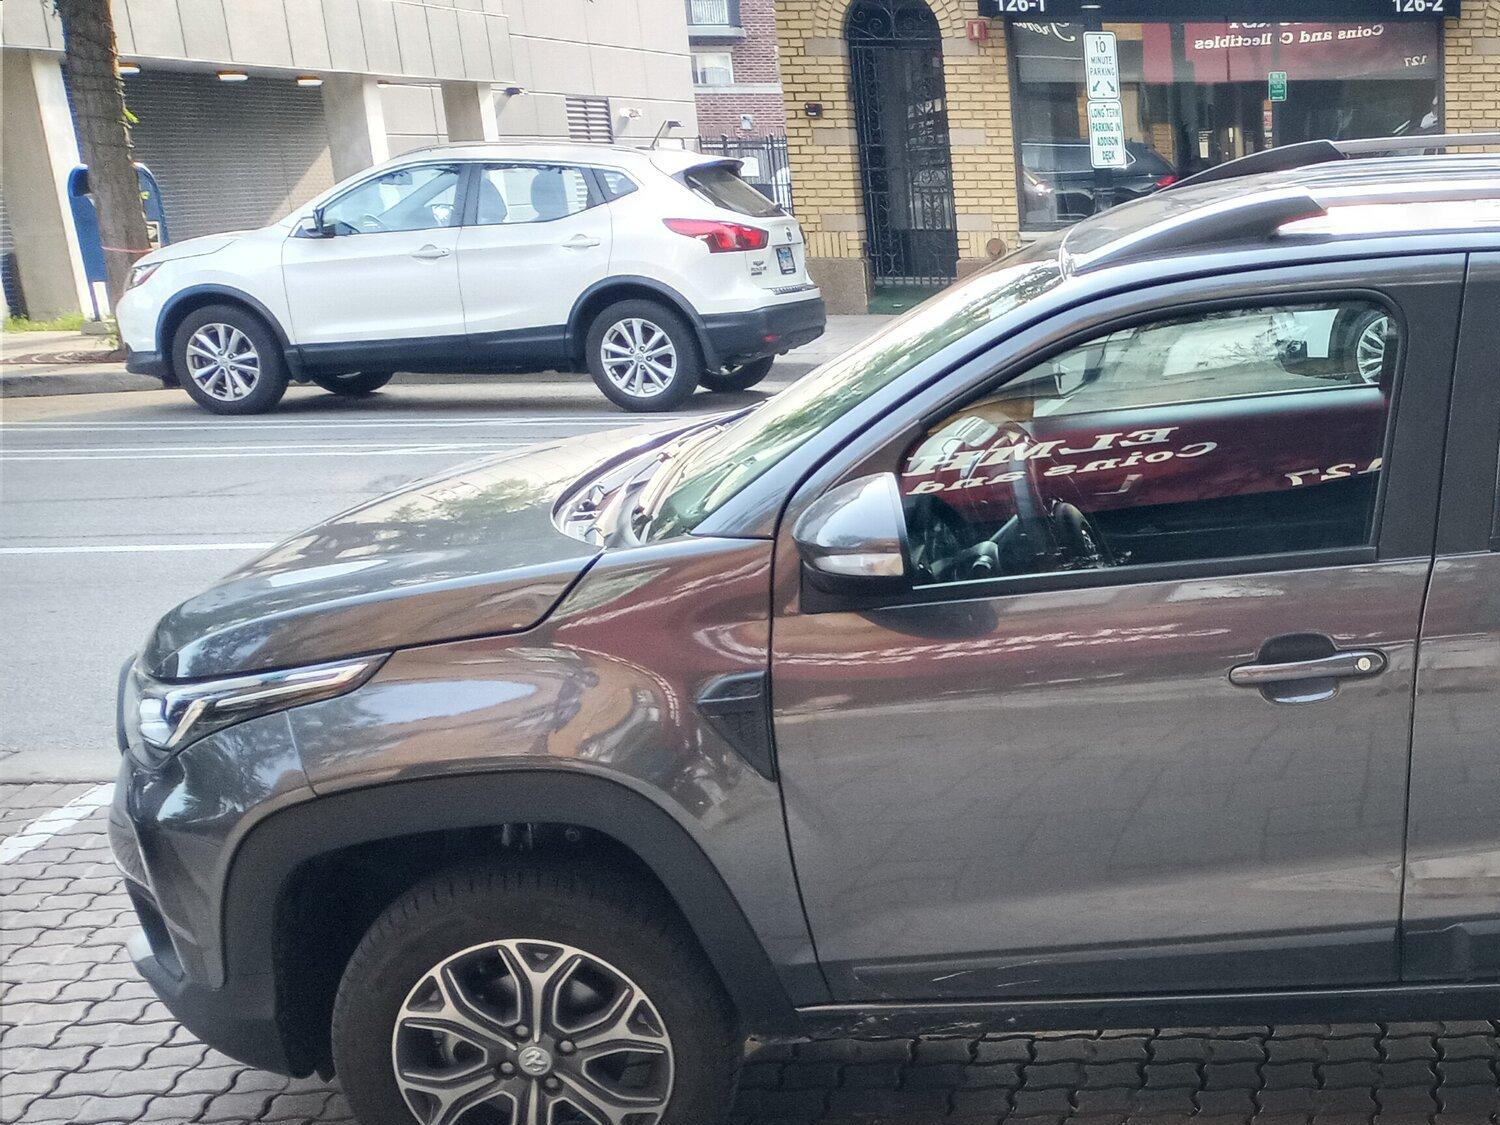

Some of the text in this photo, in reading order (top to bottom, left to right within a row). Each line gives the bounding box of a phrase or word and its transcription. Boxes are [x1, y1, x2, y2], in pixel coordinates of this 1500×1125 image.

[1095, 41, 1106, 53] 10
[1090, 56, 1112, 64] MINUTE
[1090, 67, 1115, 76] PARKING
[1091, 108, 1119, 117] LONG TERM
[1092, 122, 1121, 132] PARKING IN
[1097, 136, 1118, 146] ADDISON
[1102, 150, 1115, 160] DECK
